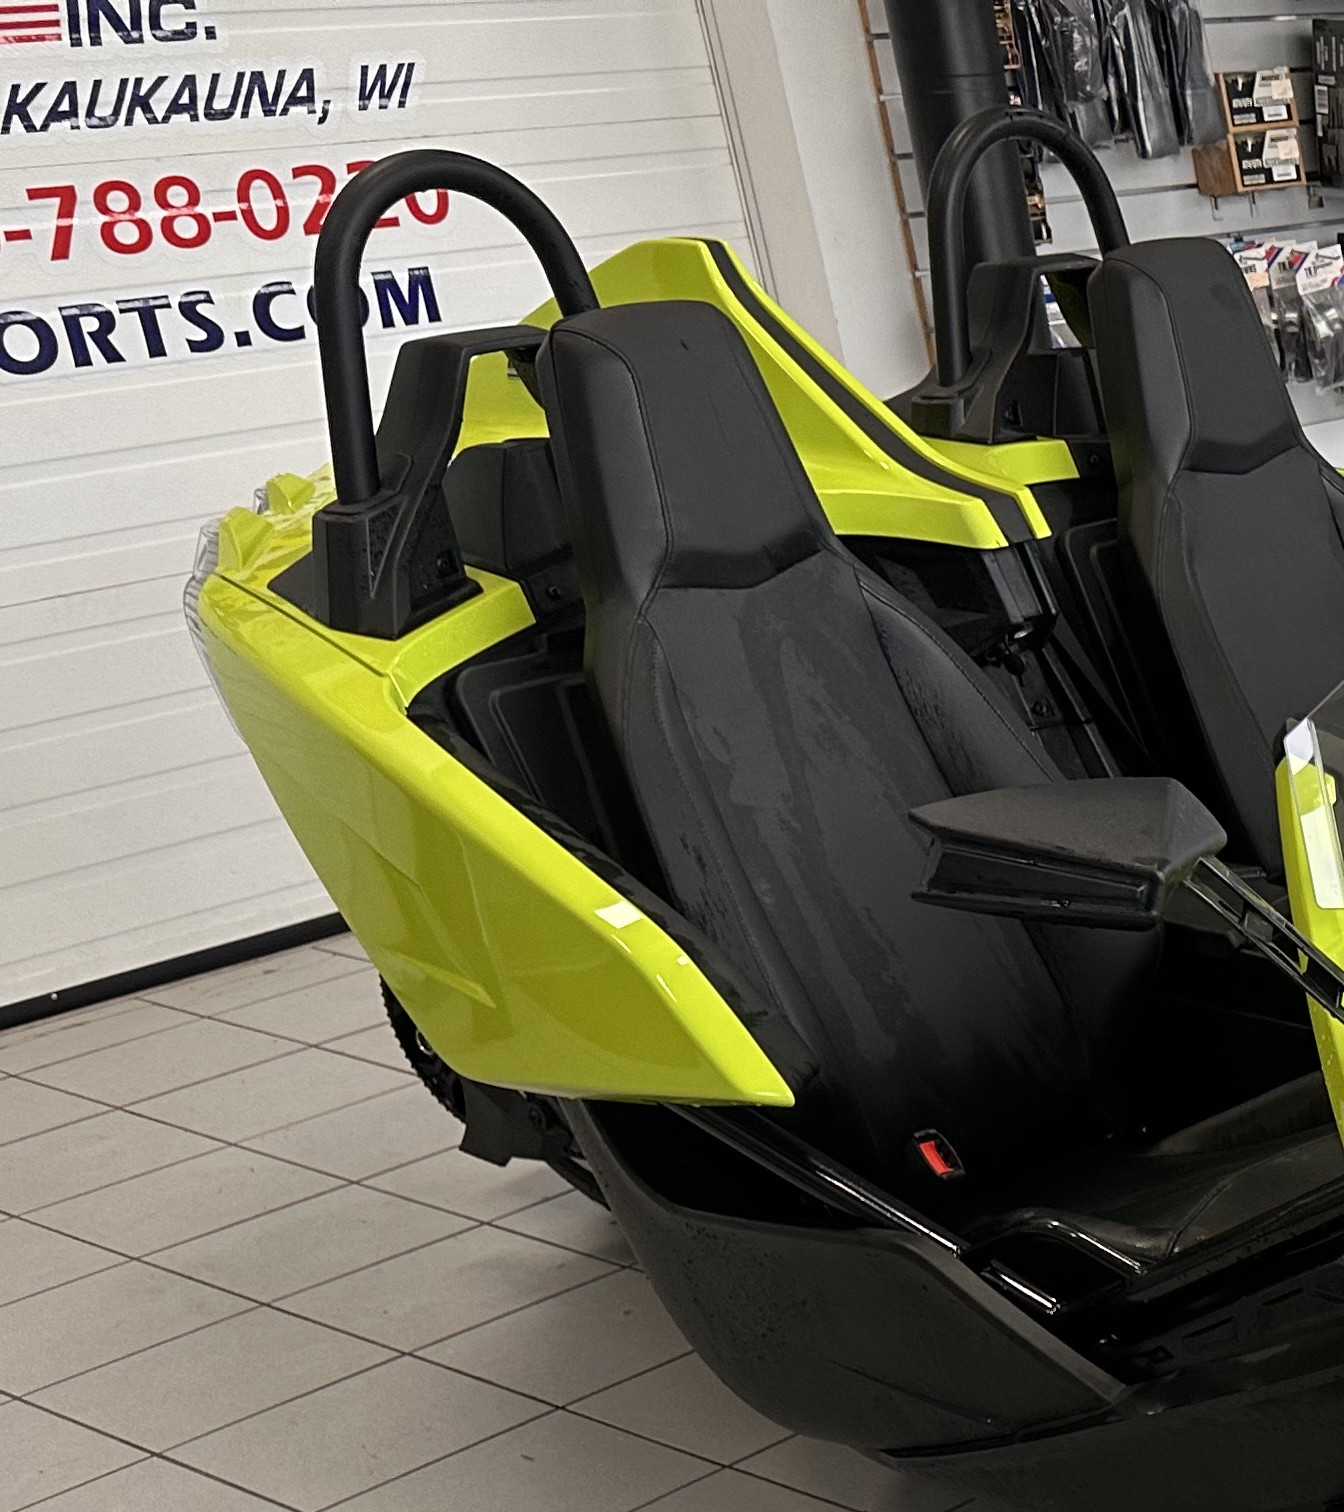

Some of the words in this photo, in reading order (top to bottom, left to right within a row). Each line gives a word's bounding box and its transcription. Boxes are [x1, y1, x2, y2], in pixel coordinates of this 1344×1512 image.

[67, 0, 217, 48] INC.
[0, 67, 332, 136] KAUKAUNA,
[356, 62, 416, 111] WI
